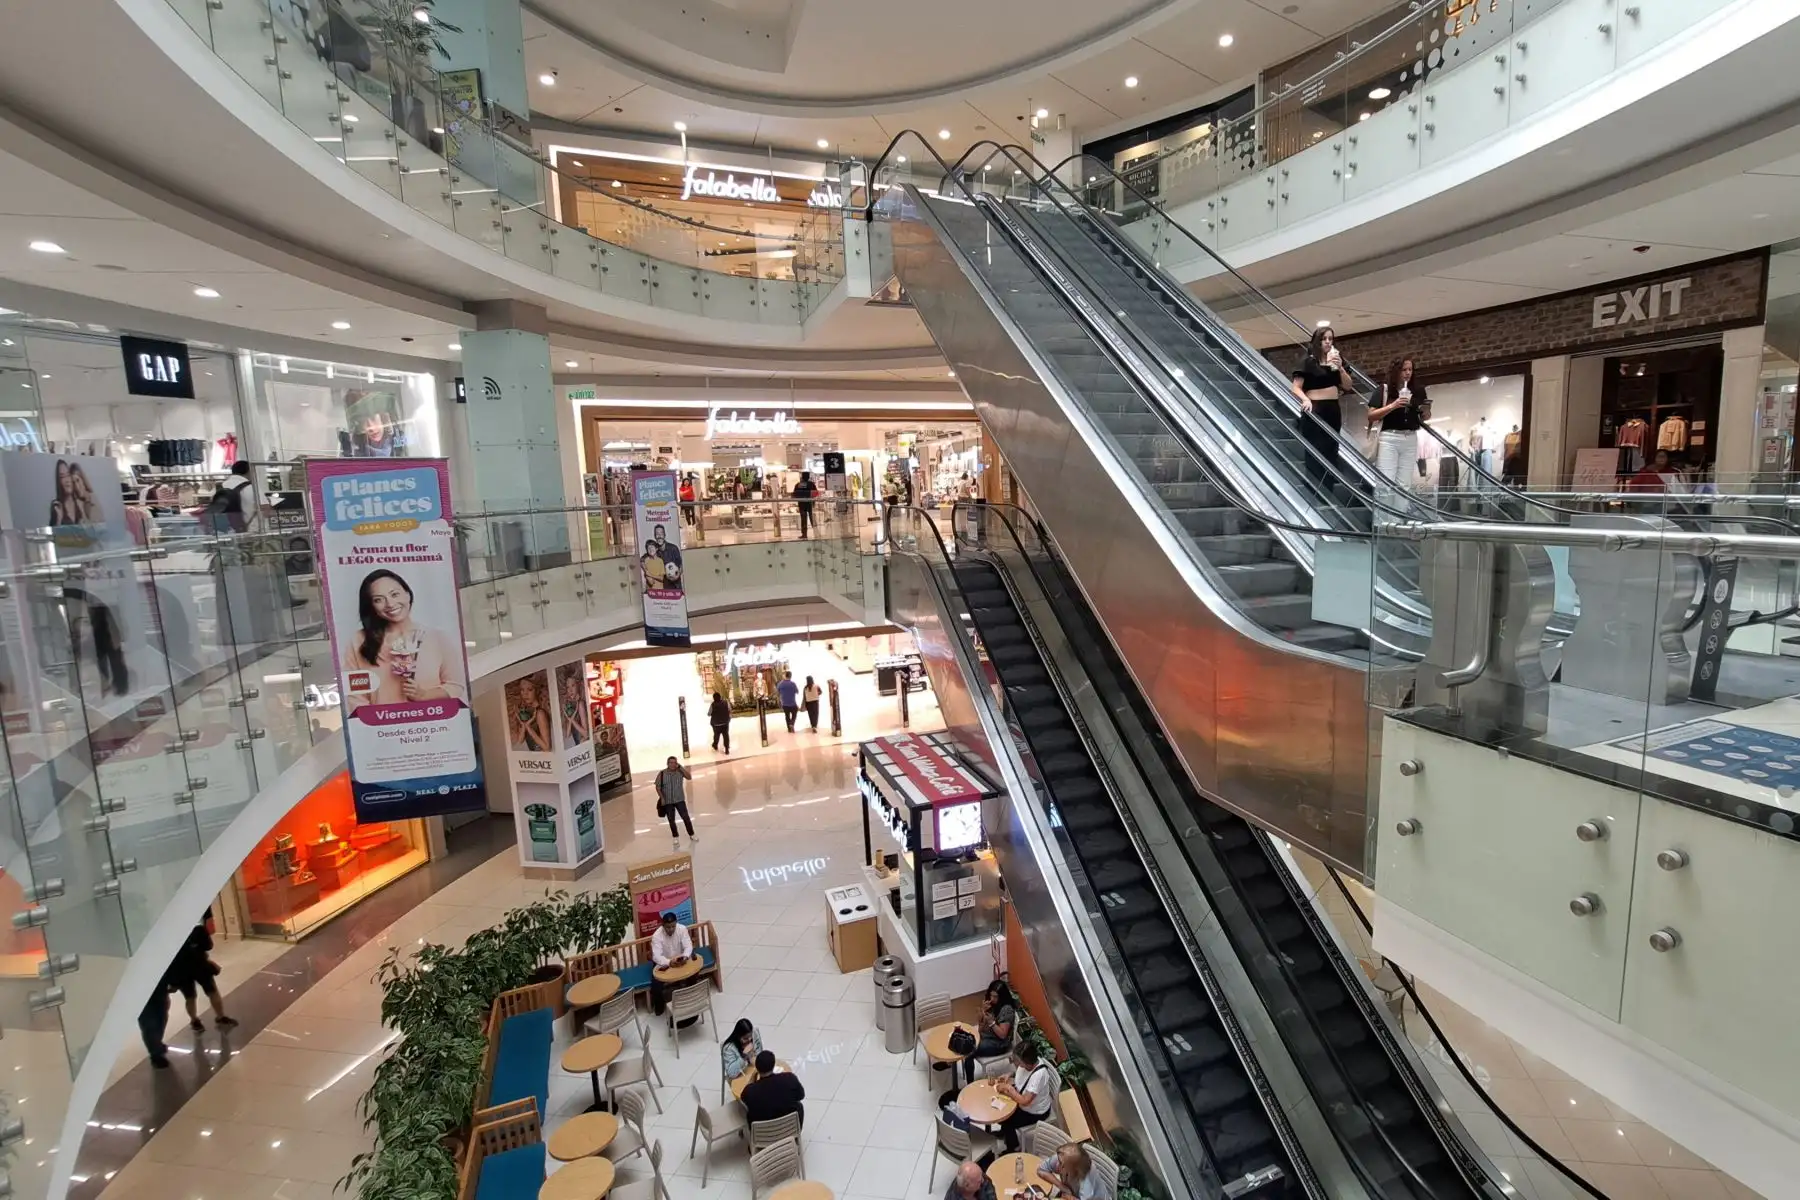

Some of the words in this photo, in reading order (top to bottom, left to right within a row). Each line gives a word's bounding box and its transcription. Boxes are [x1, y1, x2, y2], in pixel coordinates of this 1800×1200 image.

[1592, 277, 1692, 329] EXIT
[139, 352, 181, 385] GAP
[830, 457, 840, 469] 3
[333, 476, 417, 498] Planes
[639, 480, 667, 489] Planes
[640, 489, 672, 500] felices
[335, 495, 433, 521] felices
[384, 520, 413, 528] TODOS
[431, 529, 452, 537] Mayo
[351, 545, 388, 554] Arma
[390, 544, 404, 553] tu
[405, 543, 429, 552] flor
[338, 555, 374, 565] LEGO
[376, 555, 401, 563] con
[402, 552, 443, 562] mamá
[351, 676, 369, 686] LEGO
[376, 709, 424, 720] Viernes
[426, 706, 444, 716] 08
[377, 728, 406, 738] Desde
[407, 727, 428, 736] 6:00
[430, 725, 451, 735] p.m.
[400, 736, 423, 745] Nivel
[424, 735, 431, 743] 2
[518, 759, 552, 770] VERSACE
[567, 750, 591, 768] VERSACE
[416, 788, 436, 796] REAL
[453, 783, 477, 792] PLAZA
[632, 873, 651, 884] Juan
[650, 868, 675, 879] Valdez
[639, 889, 662, 906] 40
[963, 899, 972, 907] 27
